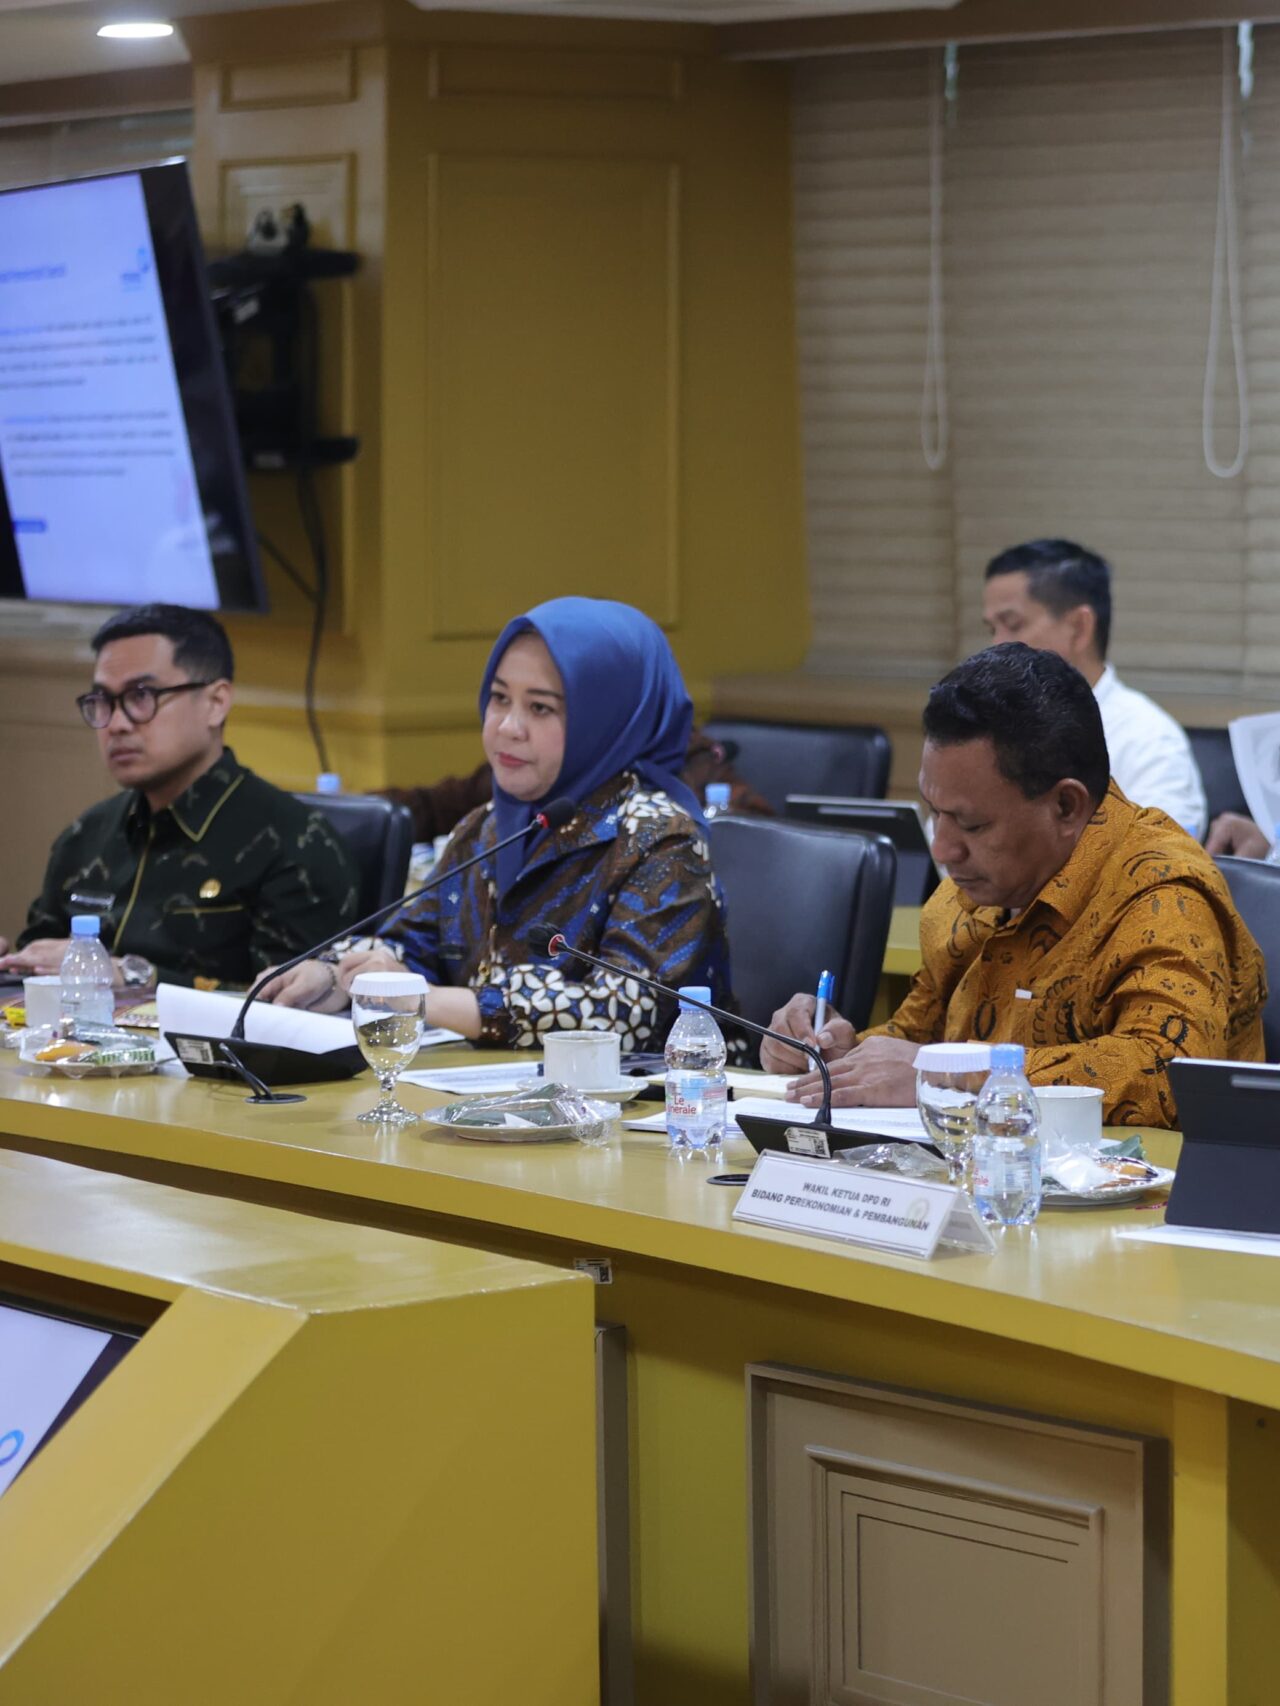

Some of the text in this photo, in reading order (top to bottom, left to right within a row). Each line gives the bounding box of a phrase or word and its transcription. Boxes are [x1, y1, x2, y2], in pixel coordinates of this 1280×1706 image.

[751, 1188, 784, 1203] BIDANG
[783, 1194, 853, 1217] PEREKONOMIAN
[853, 1208, 861, 1218] &
[861, 1210, 930, 1231] PEMBANGUNAN
[802, 1182, 892, 1207] WAKIL KETUA DPD RI
